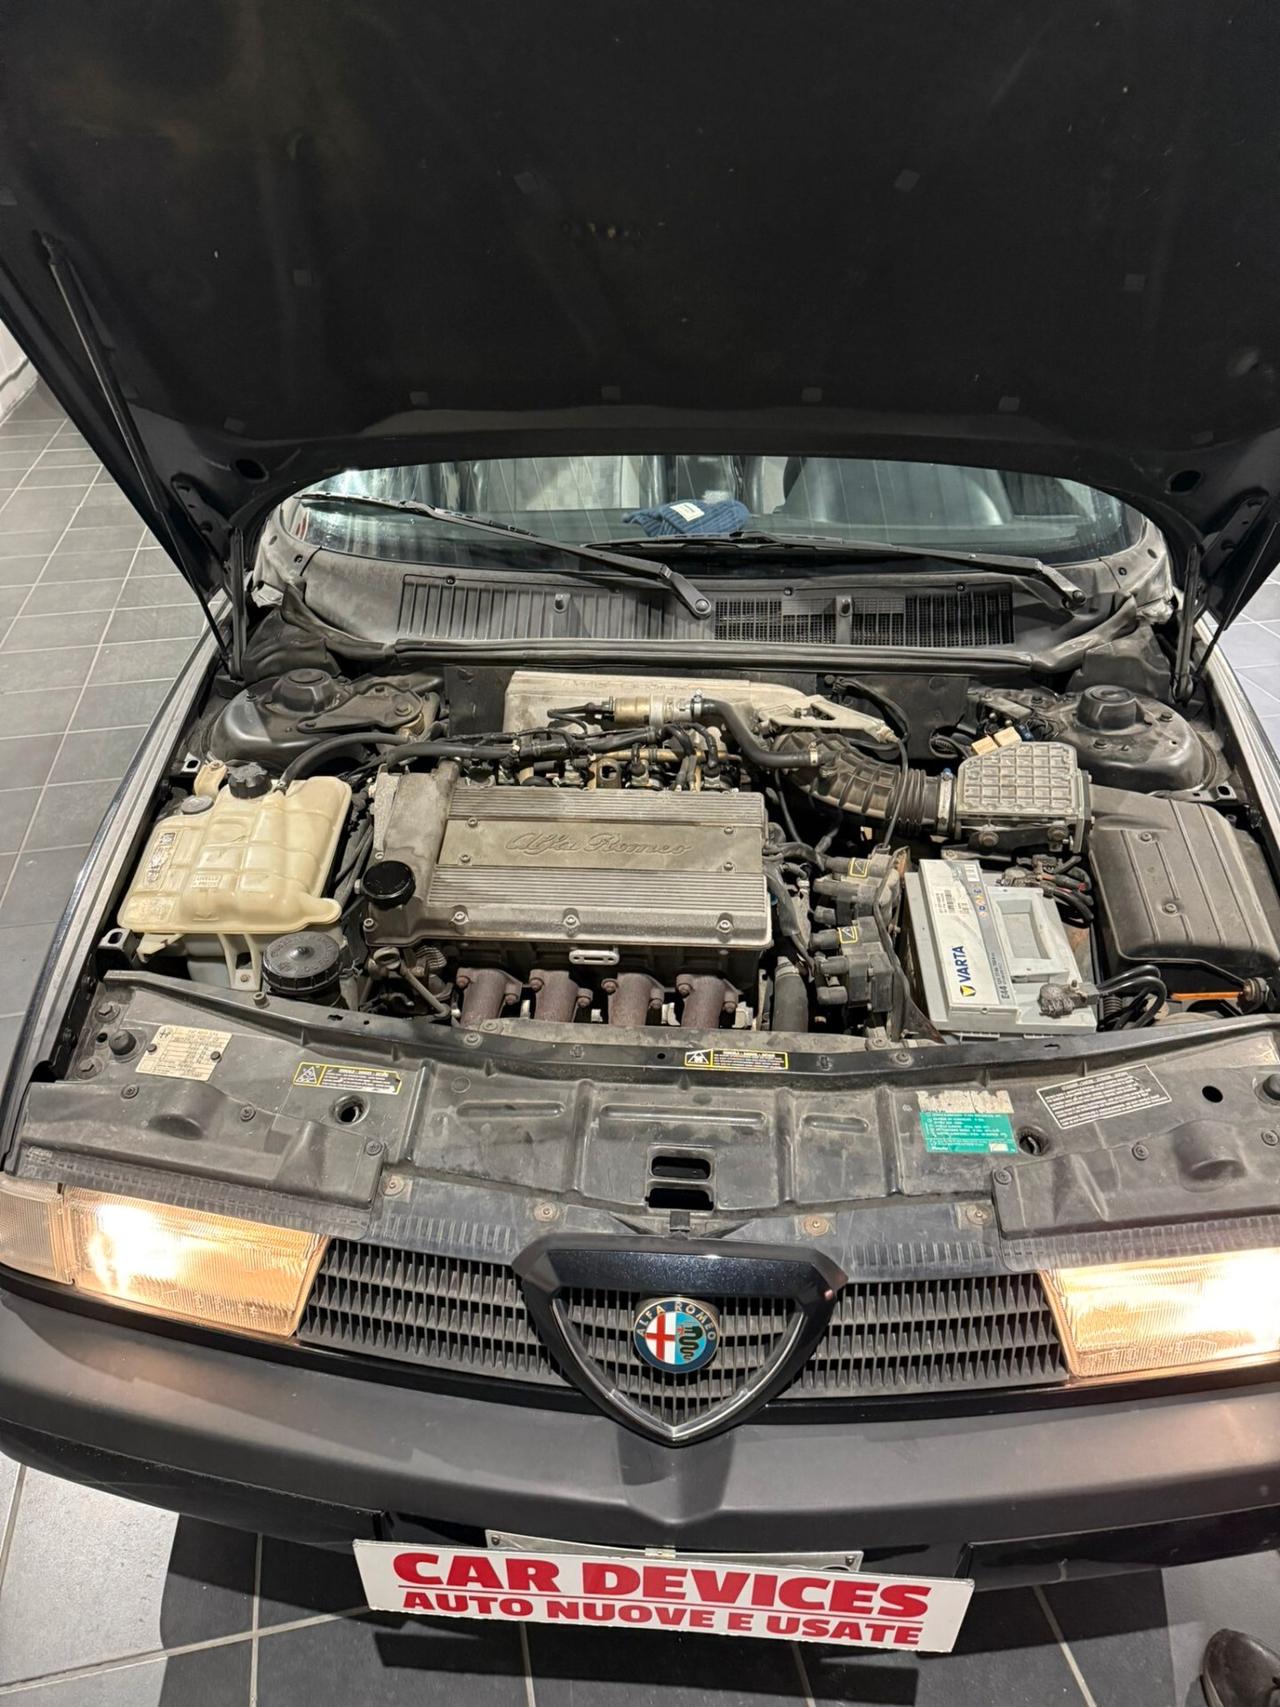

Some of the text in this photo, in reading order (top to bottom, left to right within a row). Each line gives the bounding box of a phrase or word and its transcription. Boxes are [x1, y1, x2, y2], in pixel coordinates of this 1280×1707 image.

[505, 831, 694, 856] Alfa Romeo
[952, 945, 971, 983] VARTA
[999, 986, 1010, 999] E44
[636, 1301, 716, 1341] ALFA ROMEO
[393, 1553, 932, 1618] CAR DEVICES
[403, 1591, 922, 1645] AUTO NUOVE E USATE
